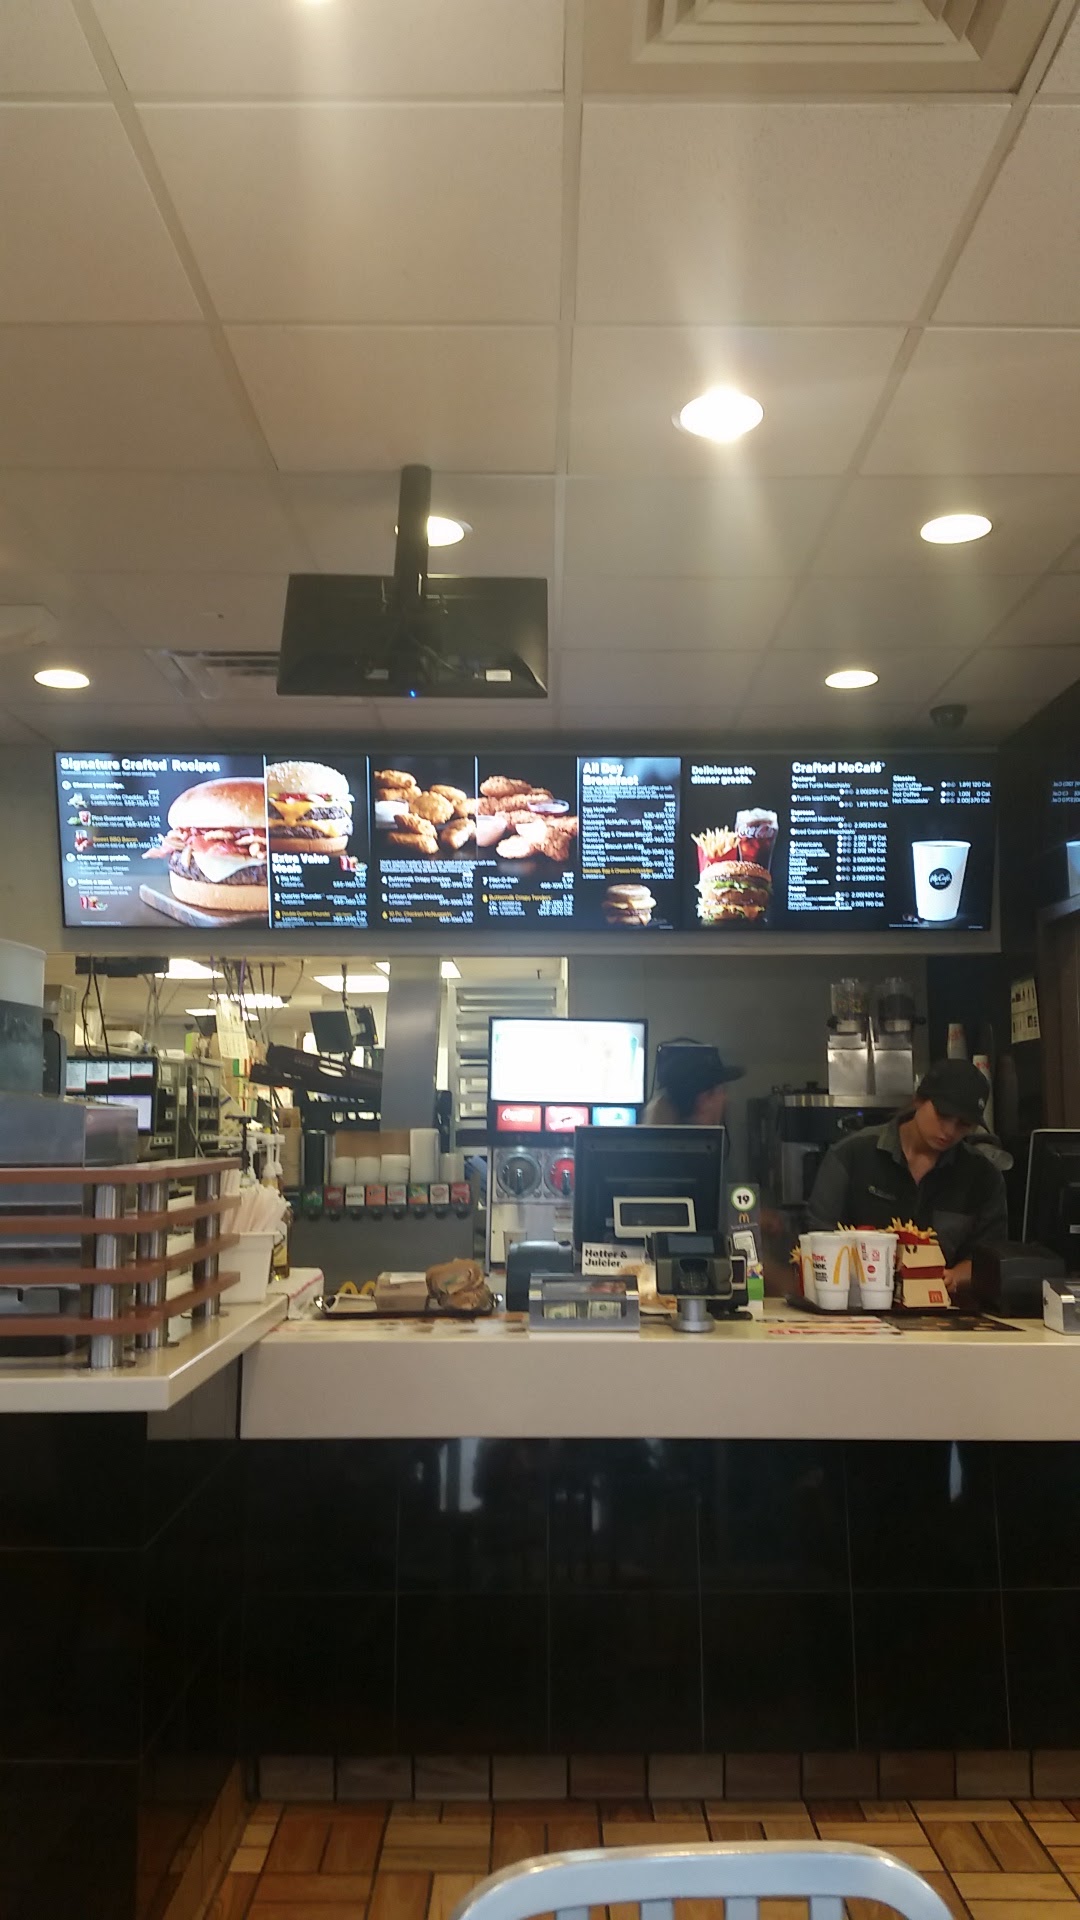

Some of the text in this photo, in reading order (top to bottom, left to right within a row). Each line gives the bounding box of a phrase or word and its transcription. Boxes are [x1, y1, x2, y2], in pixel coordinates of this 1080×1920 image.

[61, 758, 220, 773] Signature Crafted Recipes
[583, 762, 624, 776] All Day
[692, 765, 756, 776] Delicious eats,
[792, 762, 883, 774] Crafted McCafé
[583, 774, 639, 785] Breakfast
[691, 775, 752, 786] dinner greets.
[272, 853, 330, 864] Extra Value
[737, 1195, 750, 1204] 19
[620, 1251, 628, 1259] &
